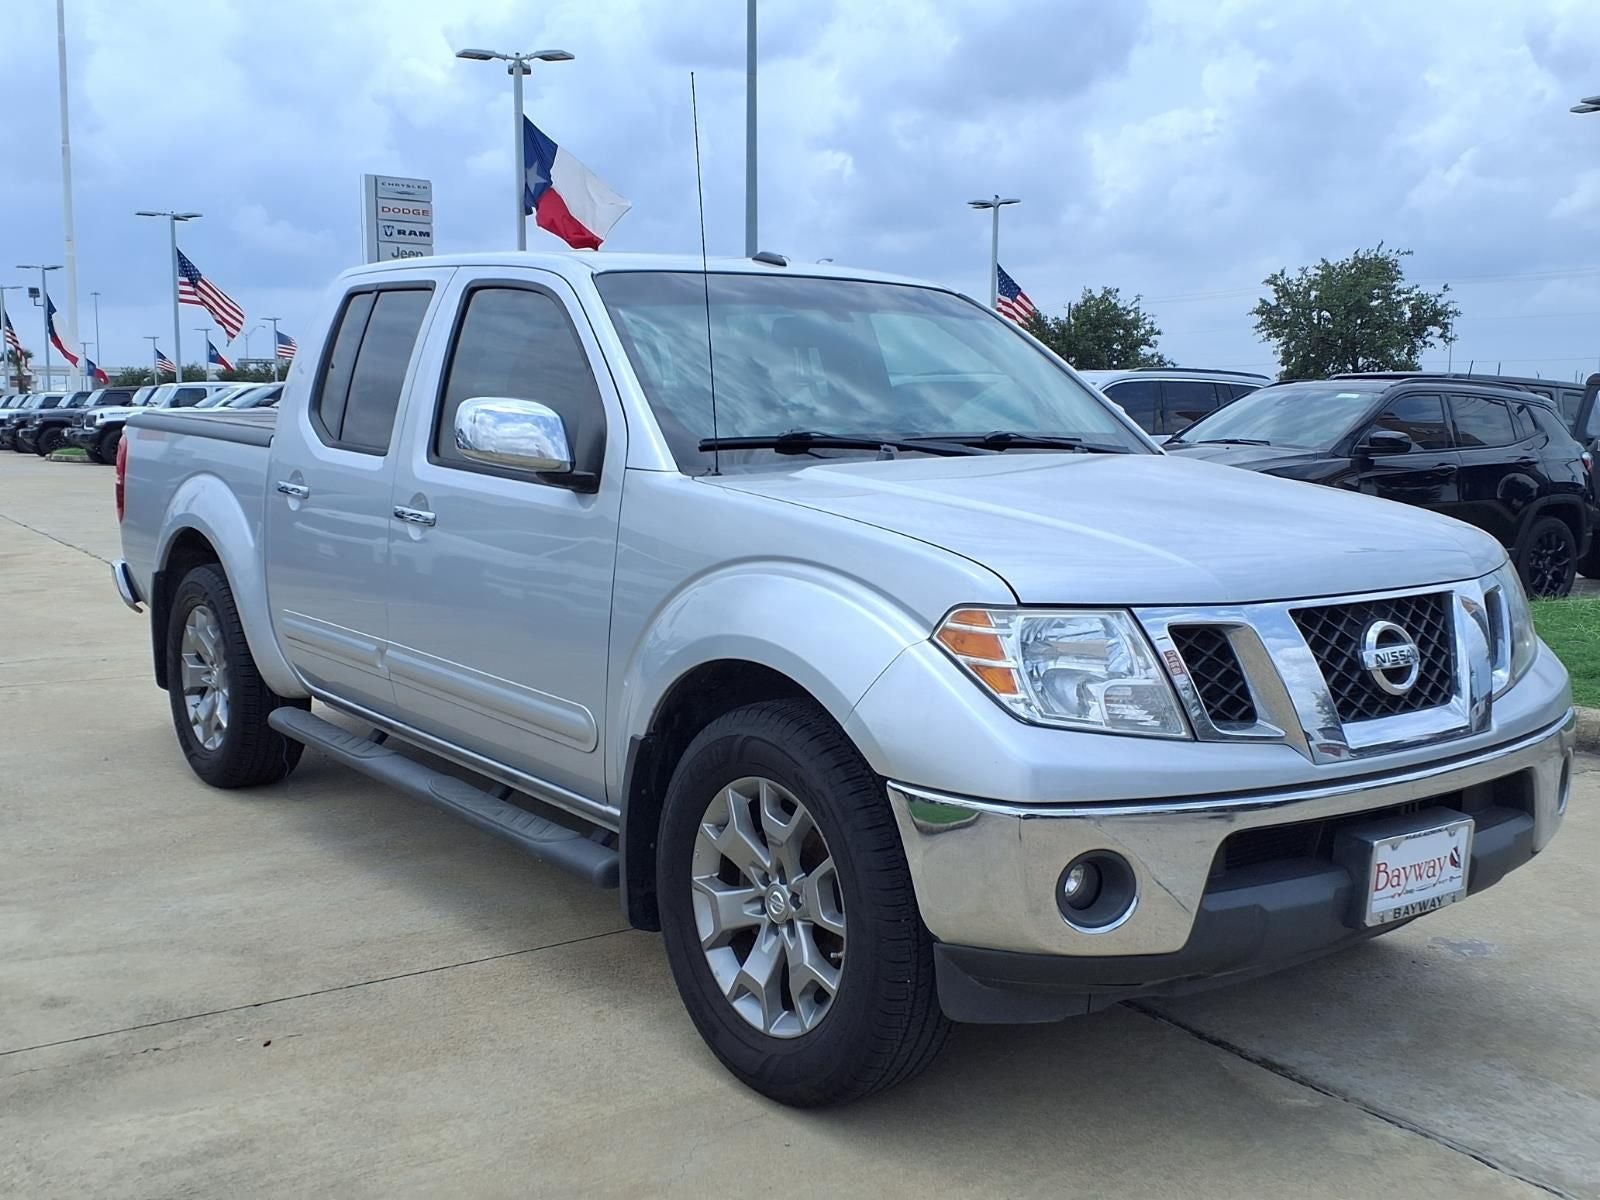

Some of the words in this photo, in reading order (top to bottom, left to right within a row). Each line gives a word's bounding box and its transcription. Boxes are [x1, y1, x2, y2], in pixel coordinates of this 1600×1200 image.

[381, 182, 428, 190] CHRYSLER
[381, 206, 430, 216] DODGE
[397, 229, 431, 238] RAM
[1375, 649, 1417, 664] NISSA
[1373, 855, 1447, 897] Bayway
[1392, 896, 1443, 919] BAYWAY
